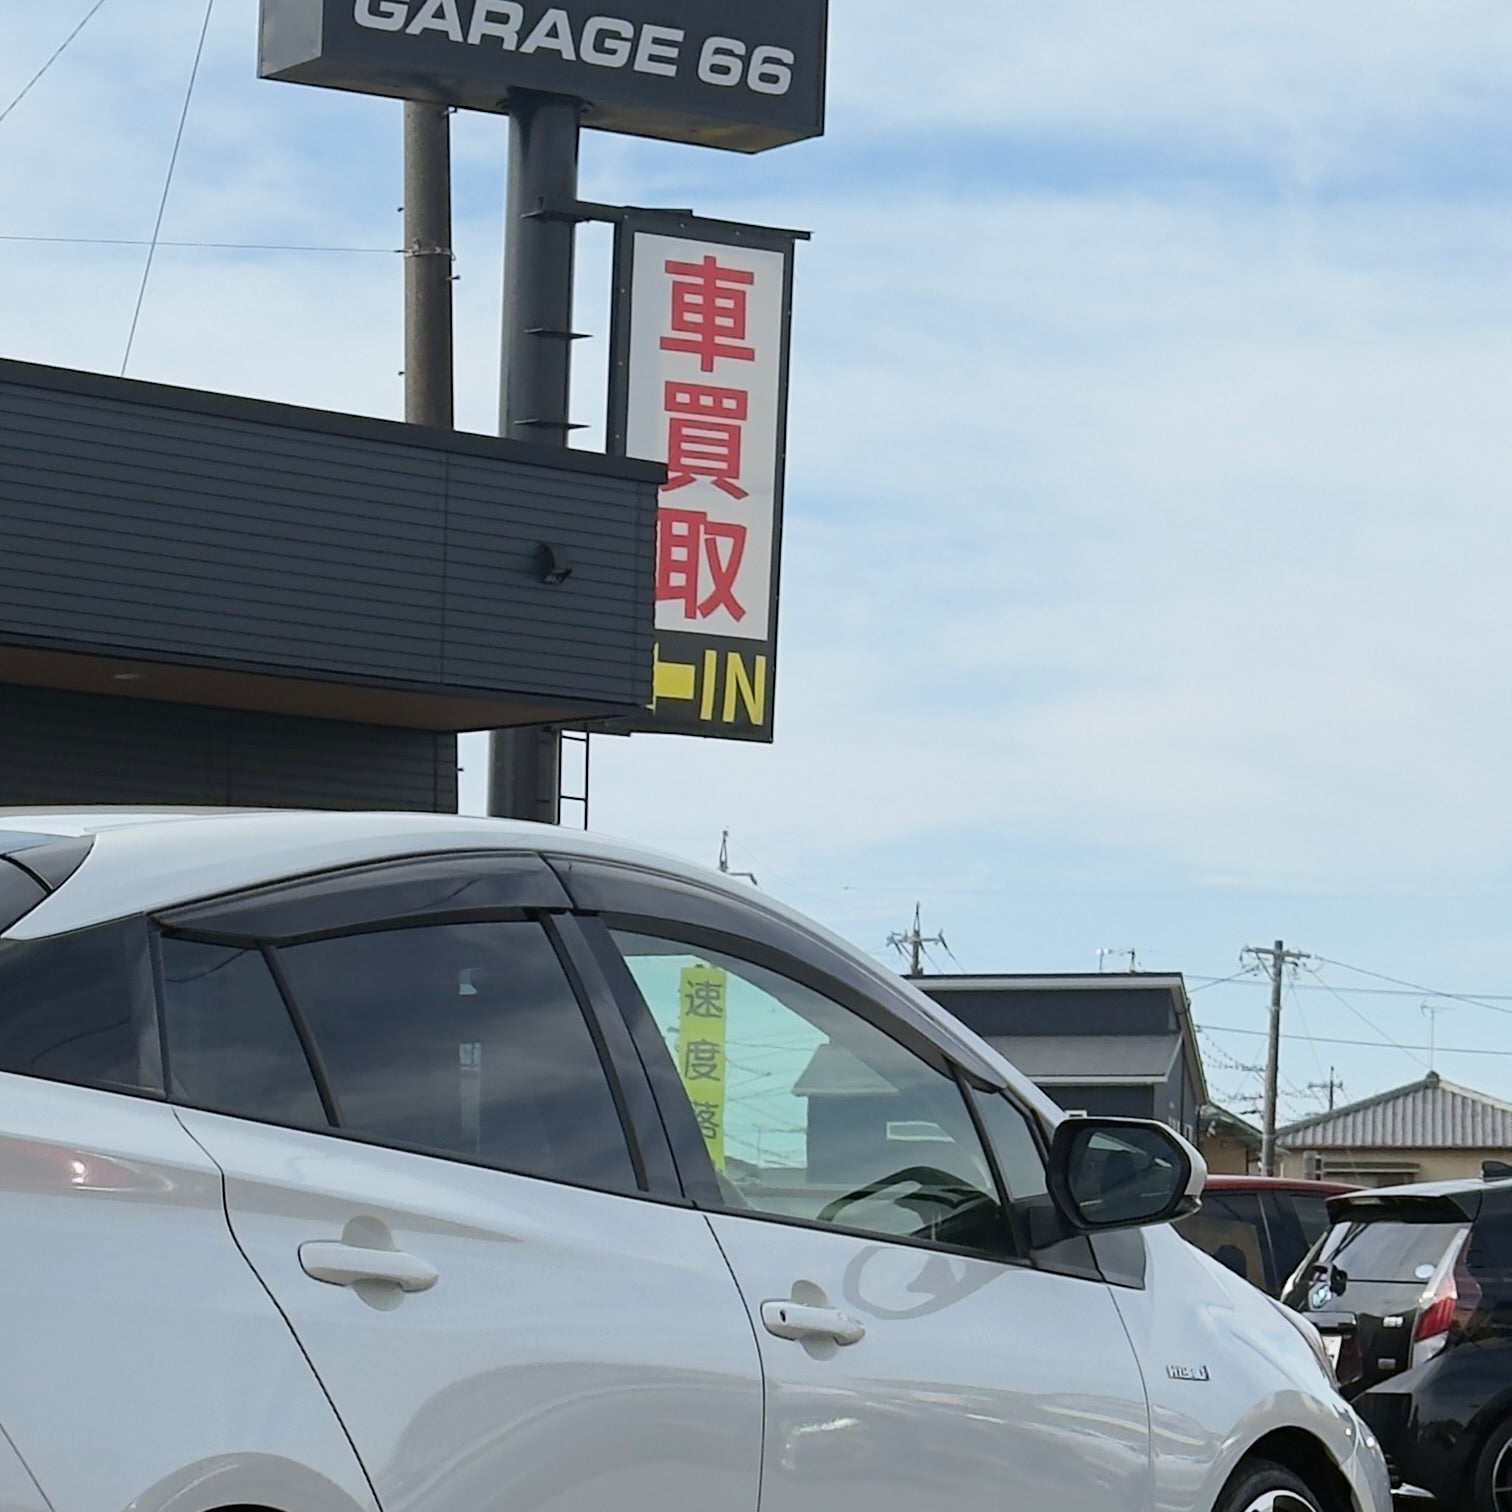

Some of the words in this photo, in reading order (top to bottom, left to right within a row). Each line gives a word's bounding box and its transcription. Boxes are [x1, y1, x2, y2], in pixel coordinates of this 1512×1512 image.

[352, 0, 685, 77] GARAGE
[697, 36, 795, 95] 66
[656, 256, 755, 622] 車買取
[700, 649, 767, 726] IN
[684, 980, 724, 1174] 速度落
